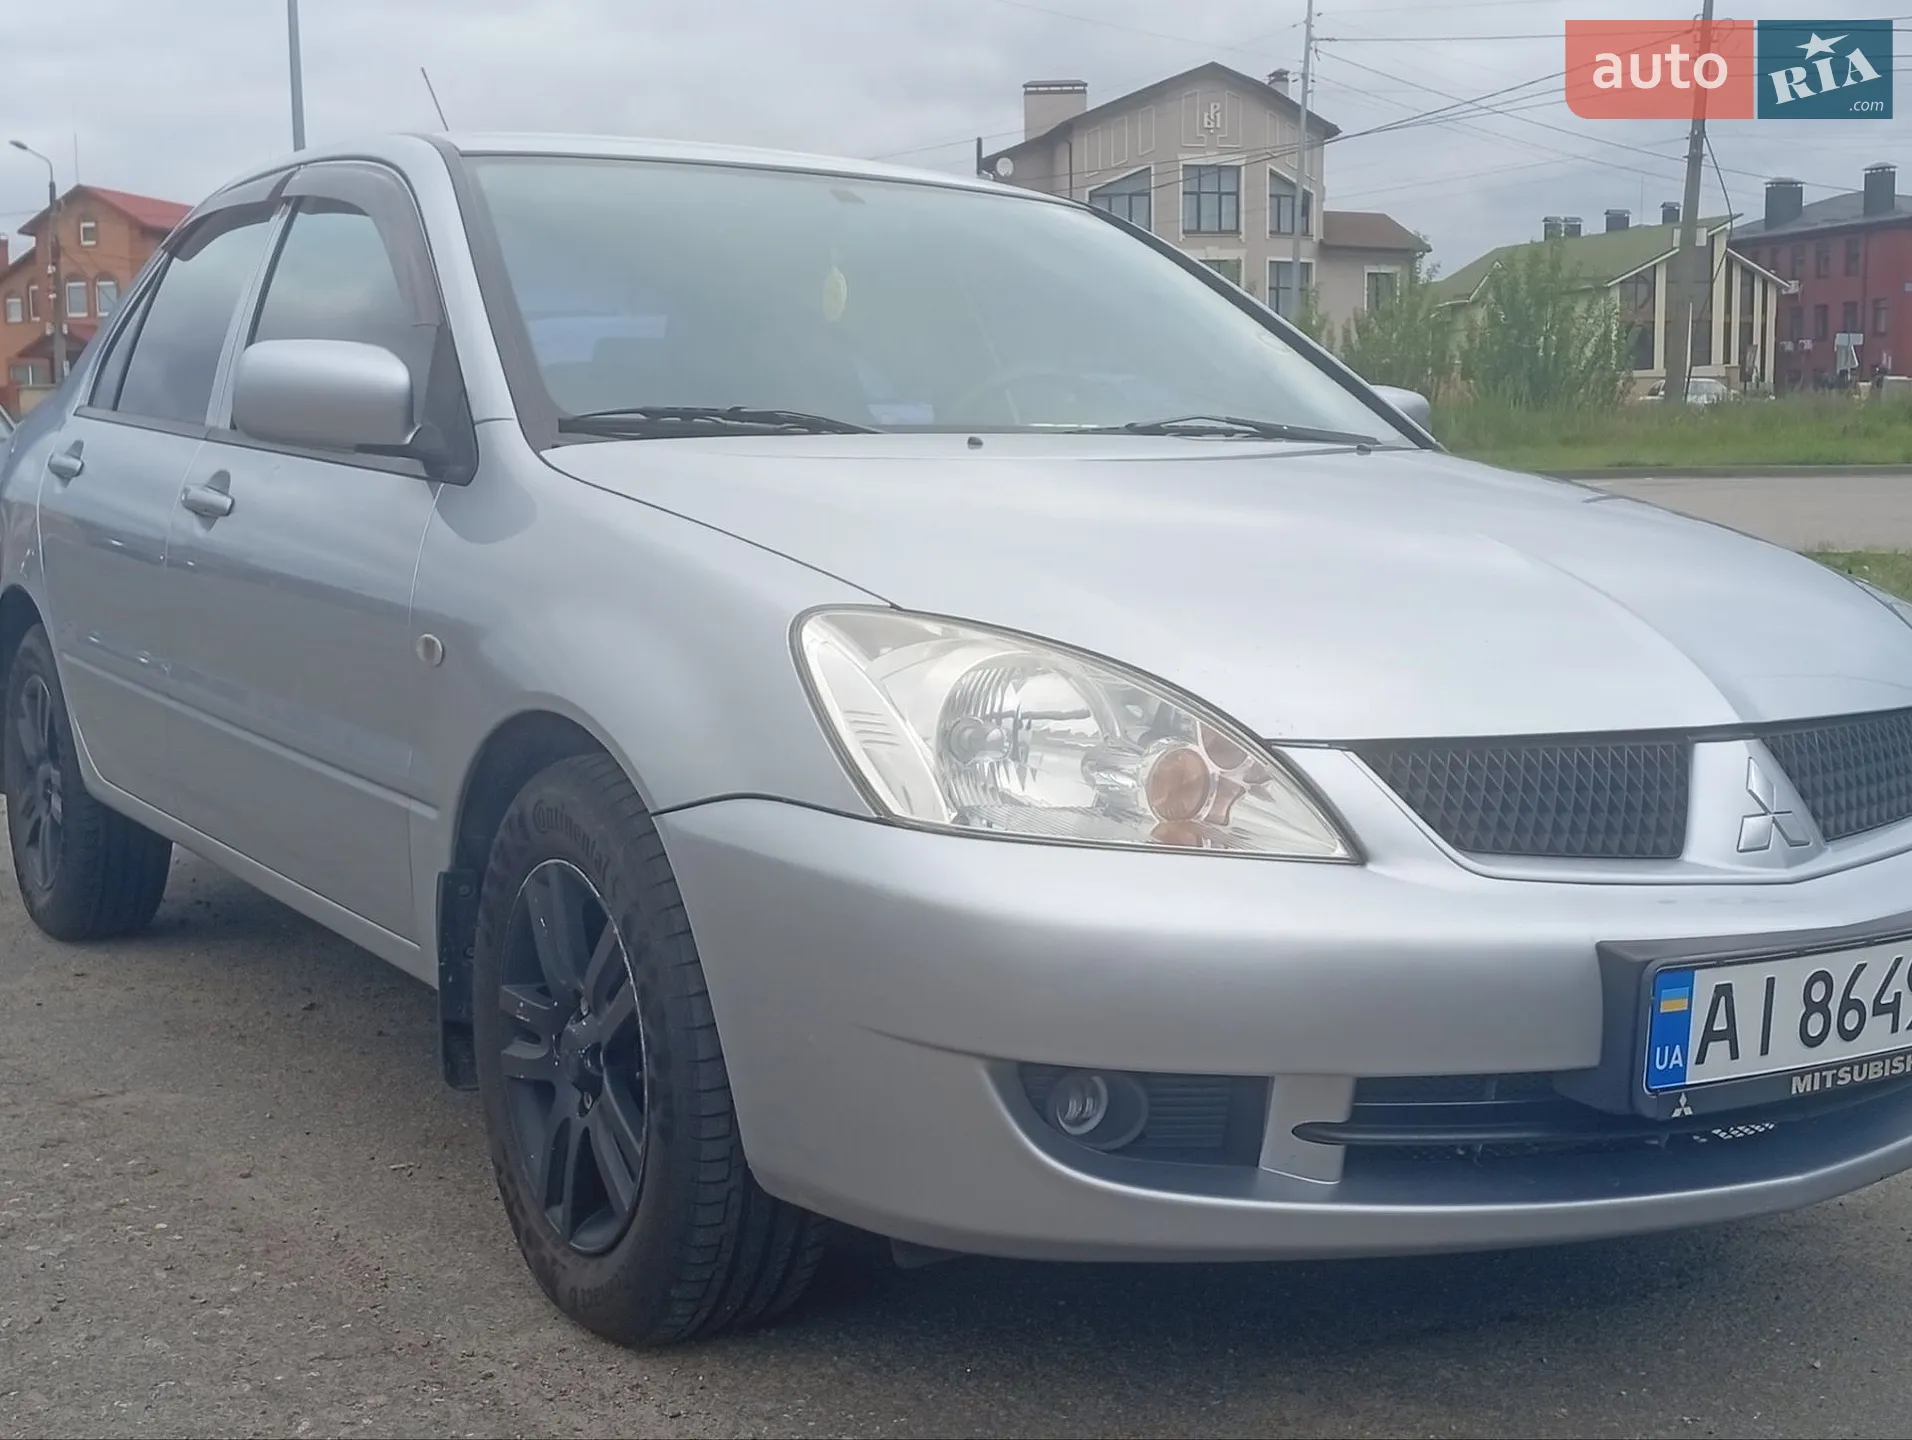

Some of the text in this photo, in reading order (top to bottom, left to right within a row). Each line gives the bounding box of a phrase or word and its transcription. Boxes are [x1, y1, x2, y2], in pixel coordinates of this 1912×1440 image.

[532, 797, 611, 883] Continental
[1655, 1044, 1683, 1070] UA
[1694, 976, 1776, 1065] AI
